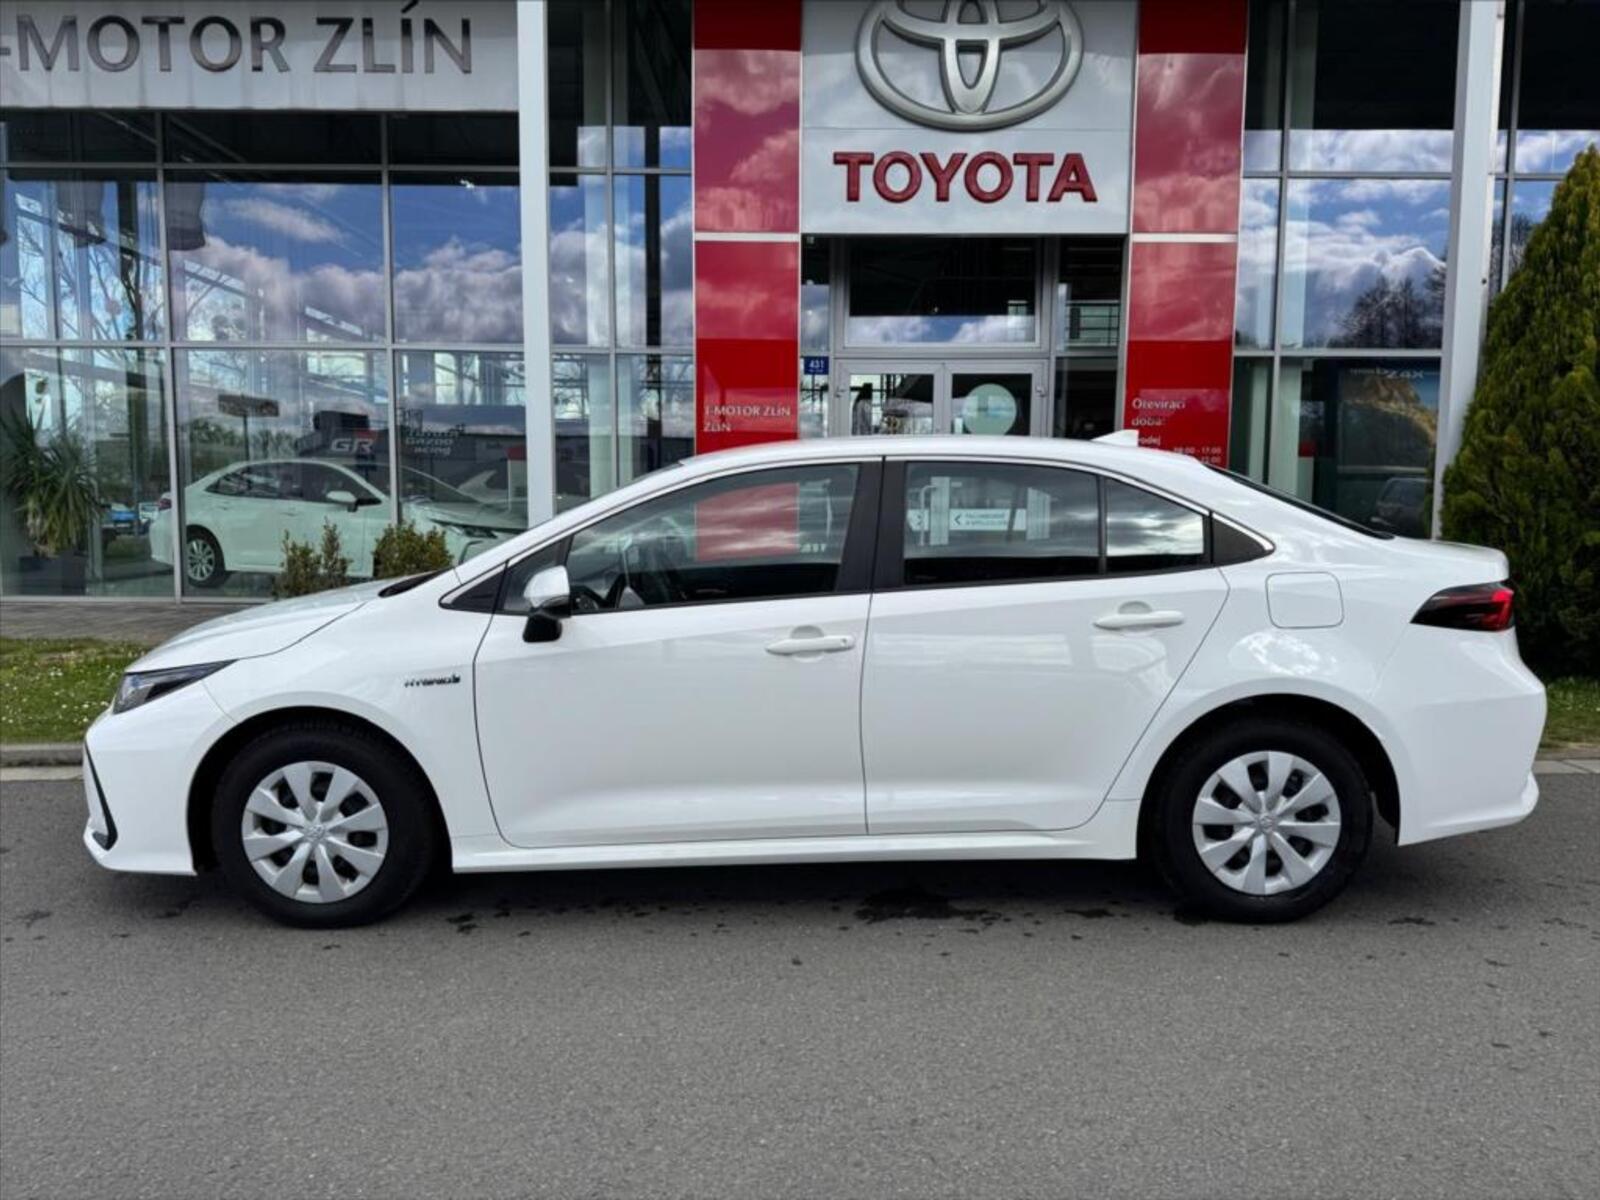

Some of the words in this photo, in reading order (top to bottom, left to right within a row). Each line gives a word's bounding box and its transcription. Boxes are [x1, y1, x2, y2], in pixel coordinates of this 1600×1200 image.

[313, 0, 473, 74] ZLÍN
[833, 151, 1098, 203] TOYOTA
[331, 438, 374, 453] GR
